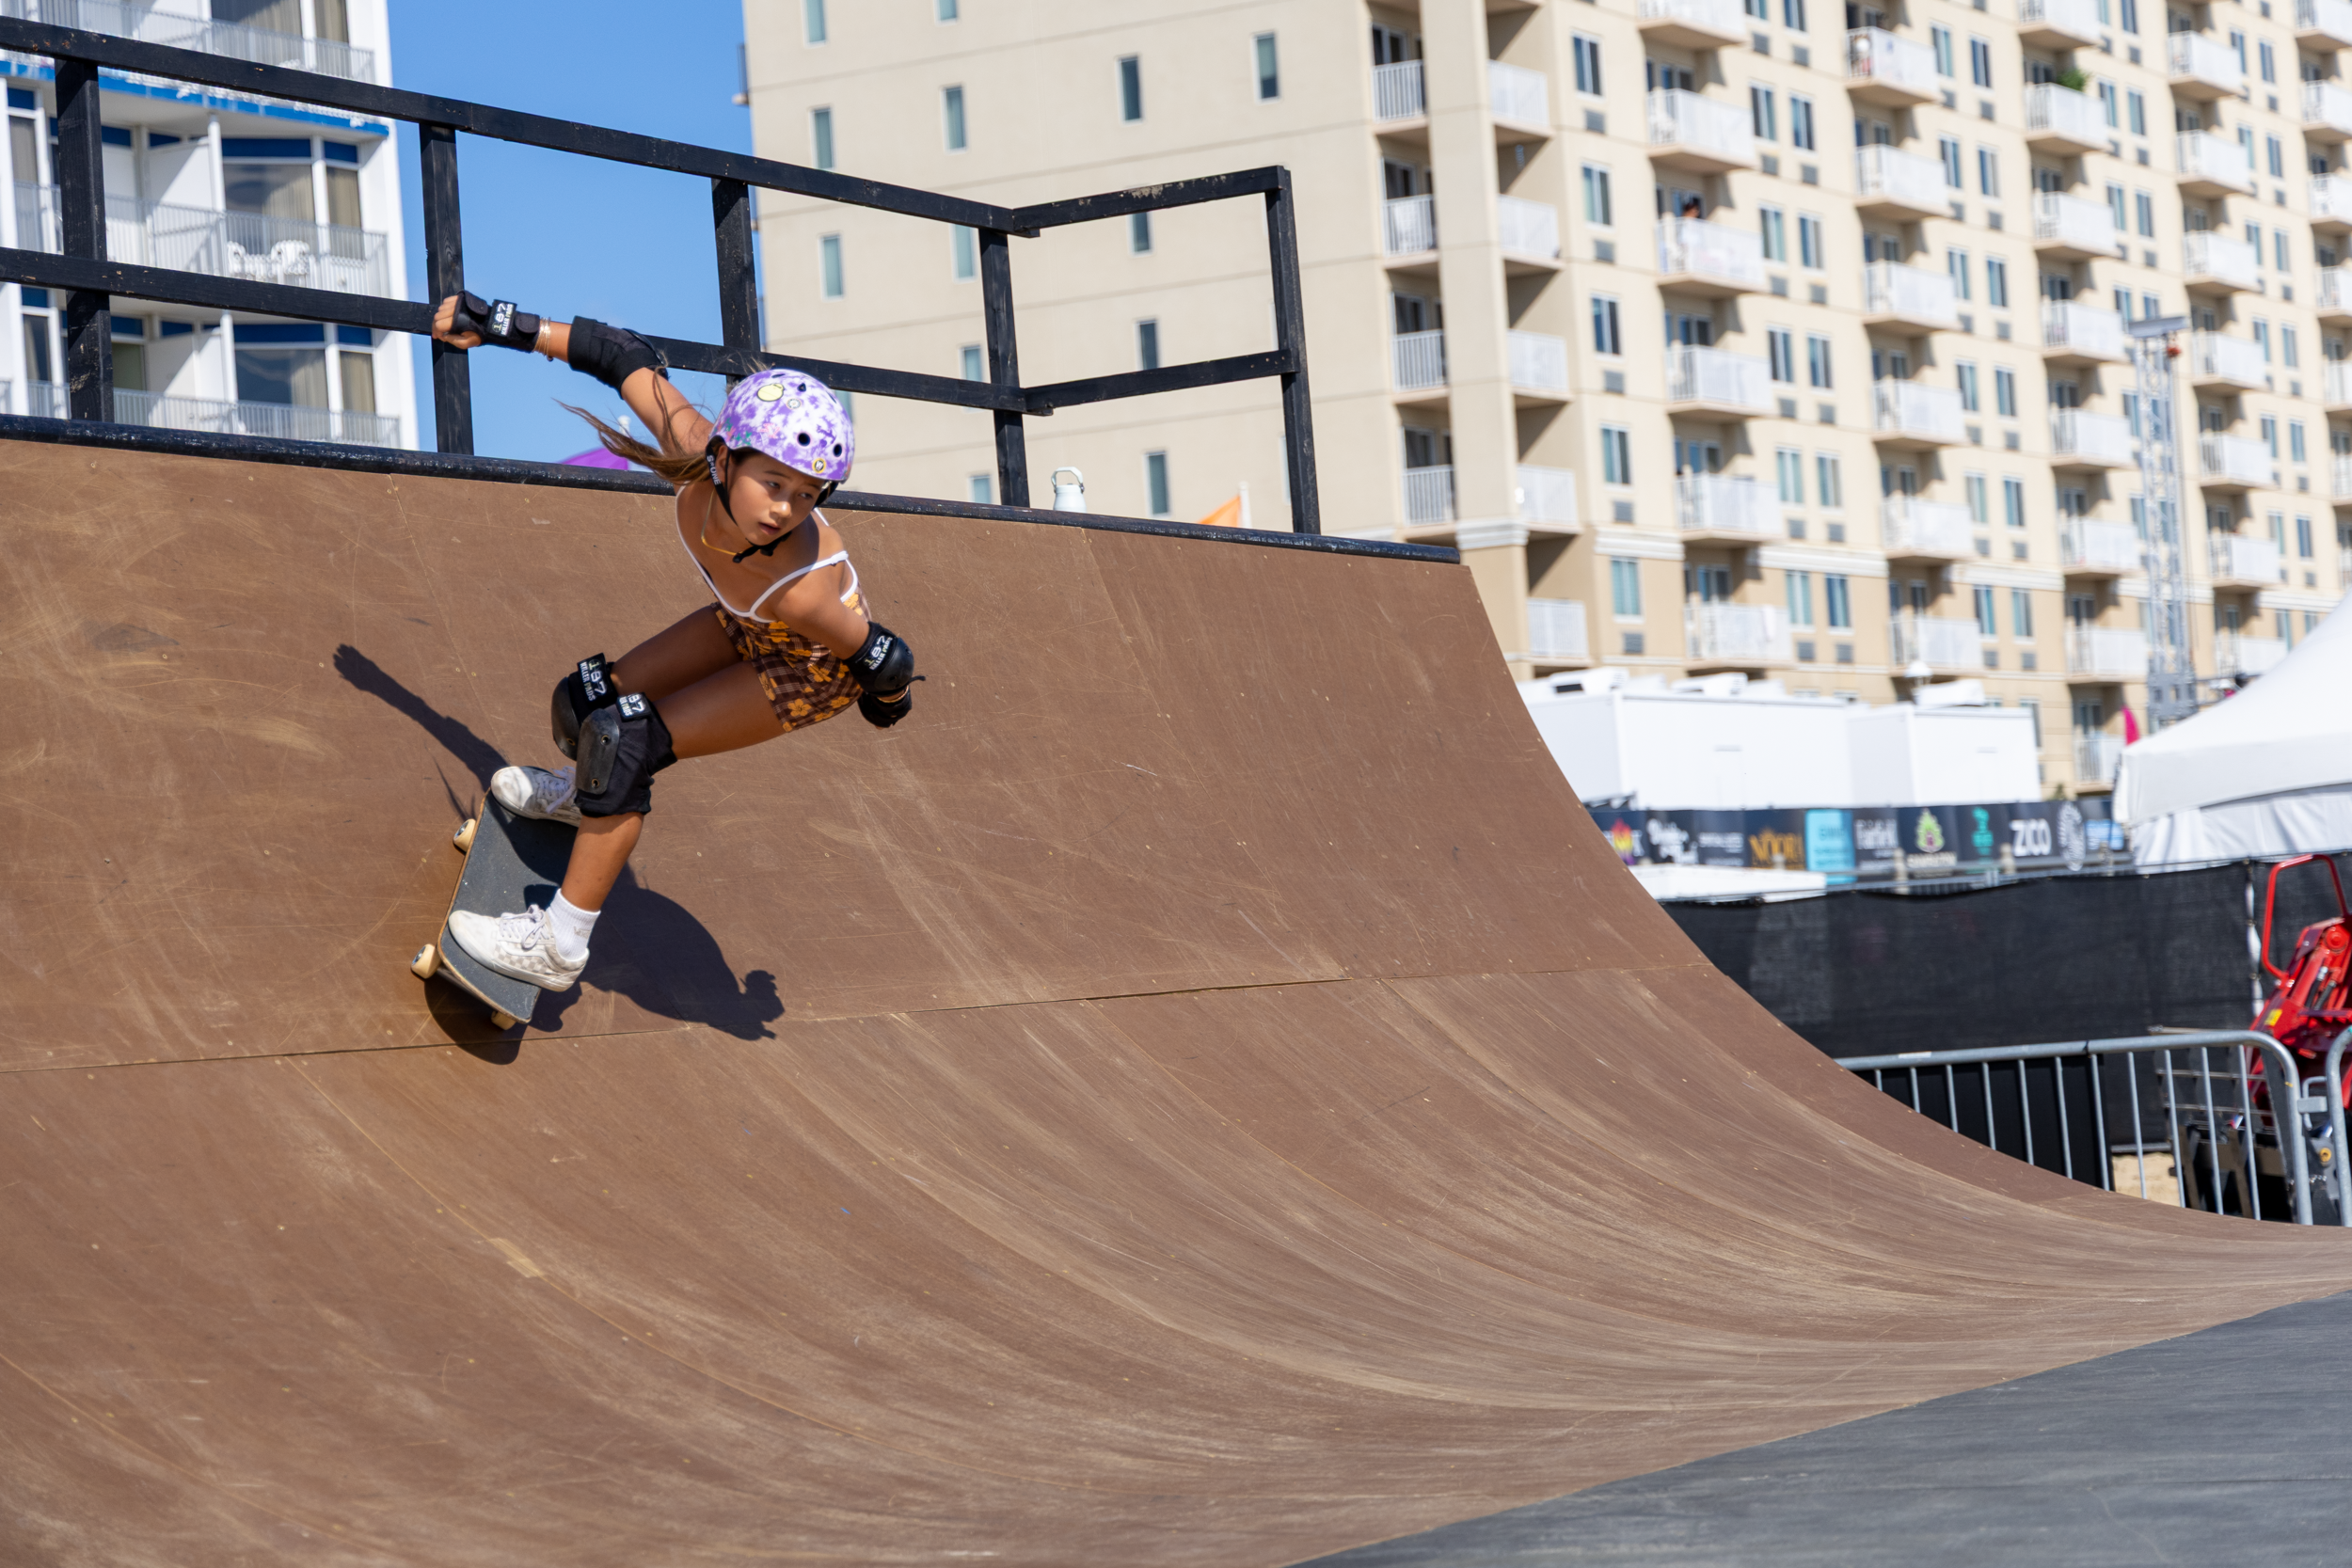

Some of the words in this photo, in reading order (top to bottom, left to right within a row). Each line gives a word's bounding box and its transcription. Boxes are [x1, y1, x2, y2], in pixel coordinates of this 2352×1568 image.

[492, 302, 506, 333] 187
[864, 635, 885, 667] 187
[583, 682, 596, 702] PADS
[588, 660, 606, 694] 187
[628, 693, 644, 712] 87
